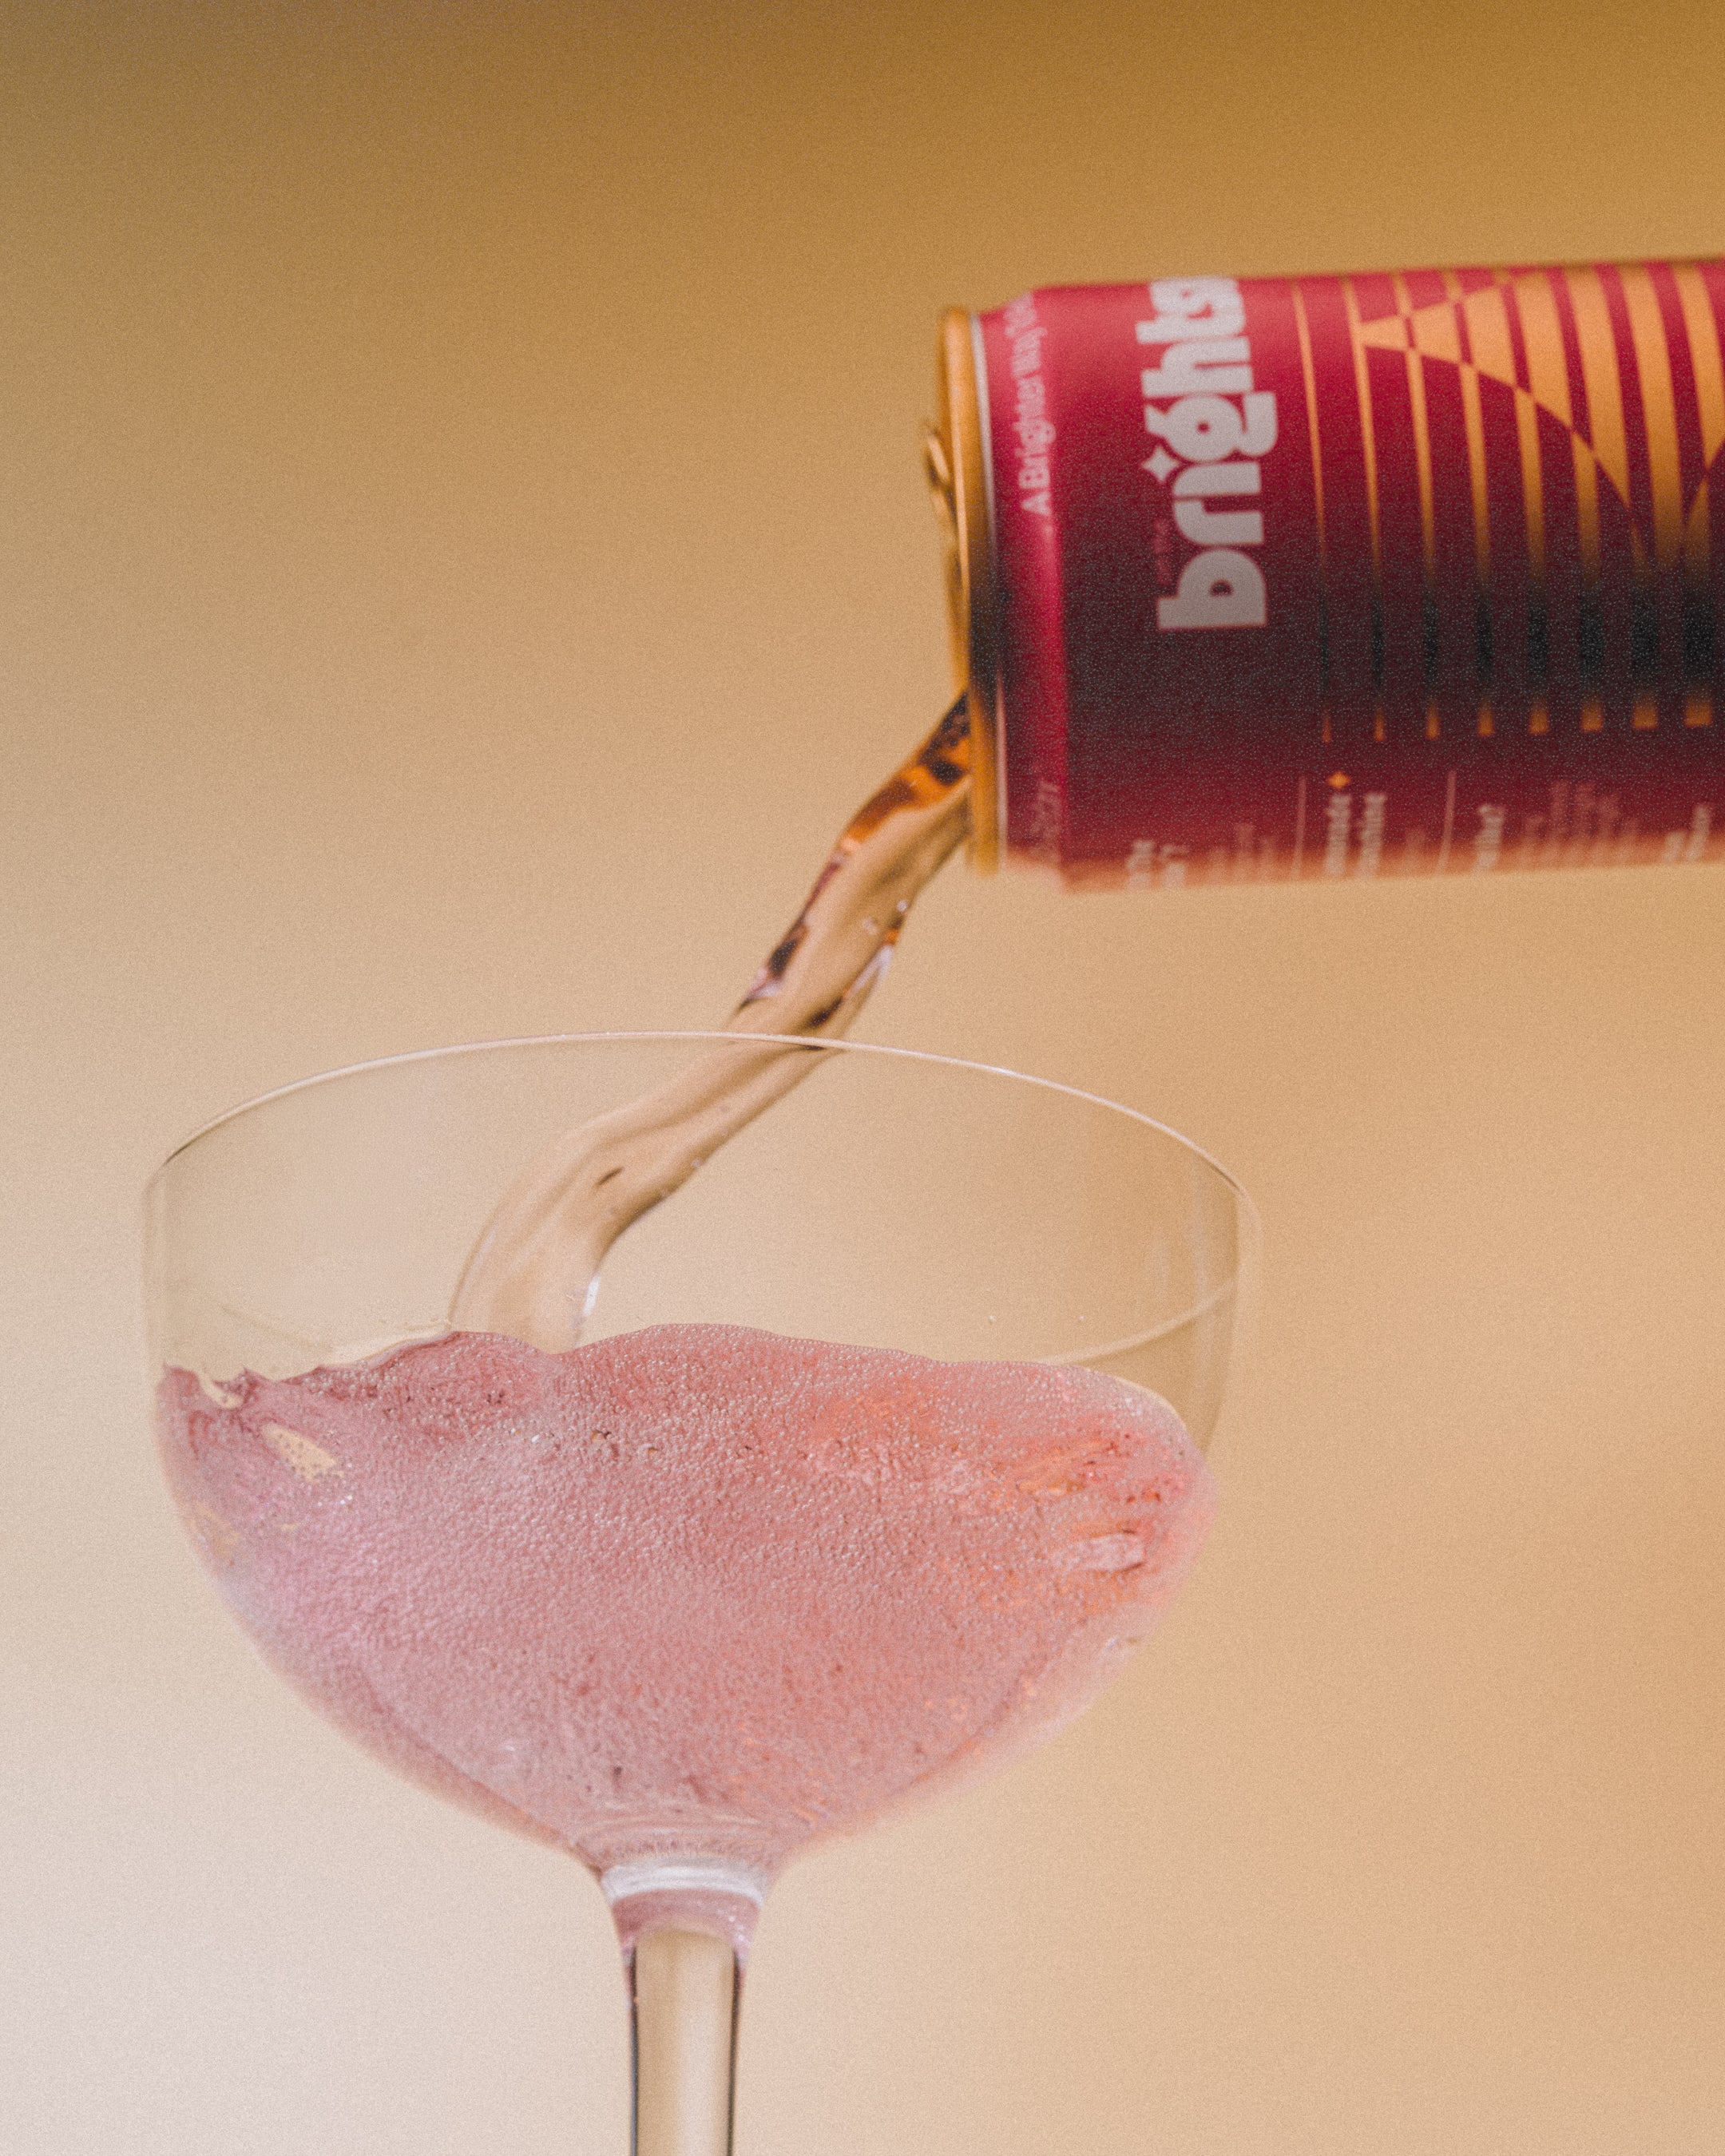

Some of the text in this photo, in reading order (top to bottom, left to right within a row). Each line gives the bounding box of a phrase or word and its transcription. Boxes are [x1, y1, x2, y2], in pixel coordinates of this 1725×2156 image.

[1011, 374, 1057, 489] Brighter
[1135, 276, 1278, 629] brights
[1021, 491, 1052, 516] A
